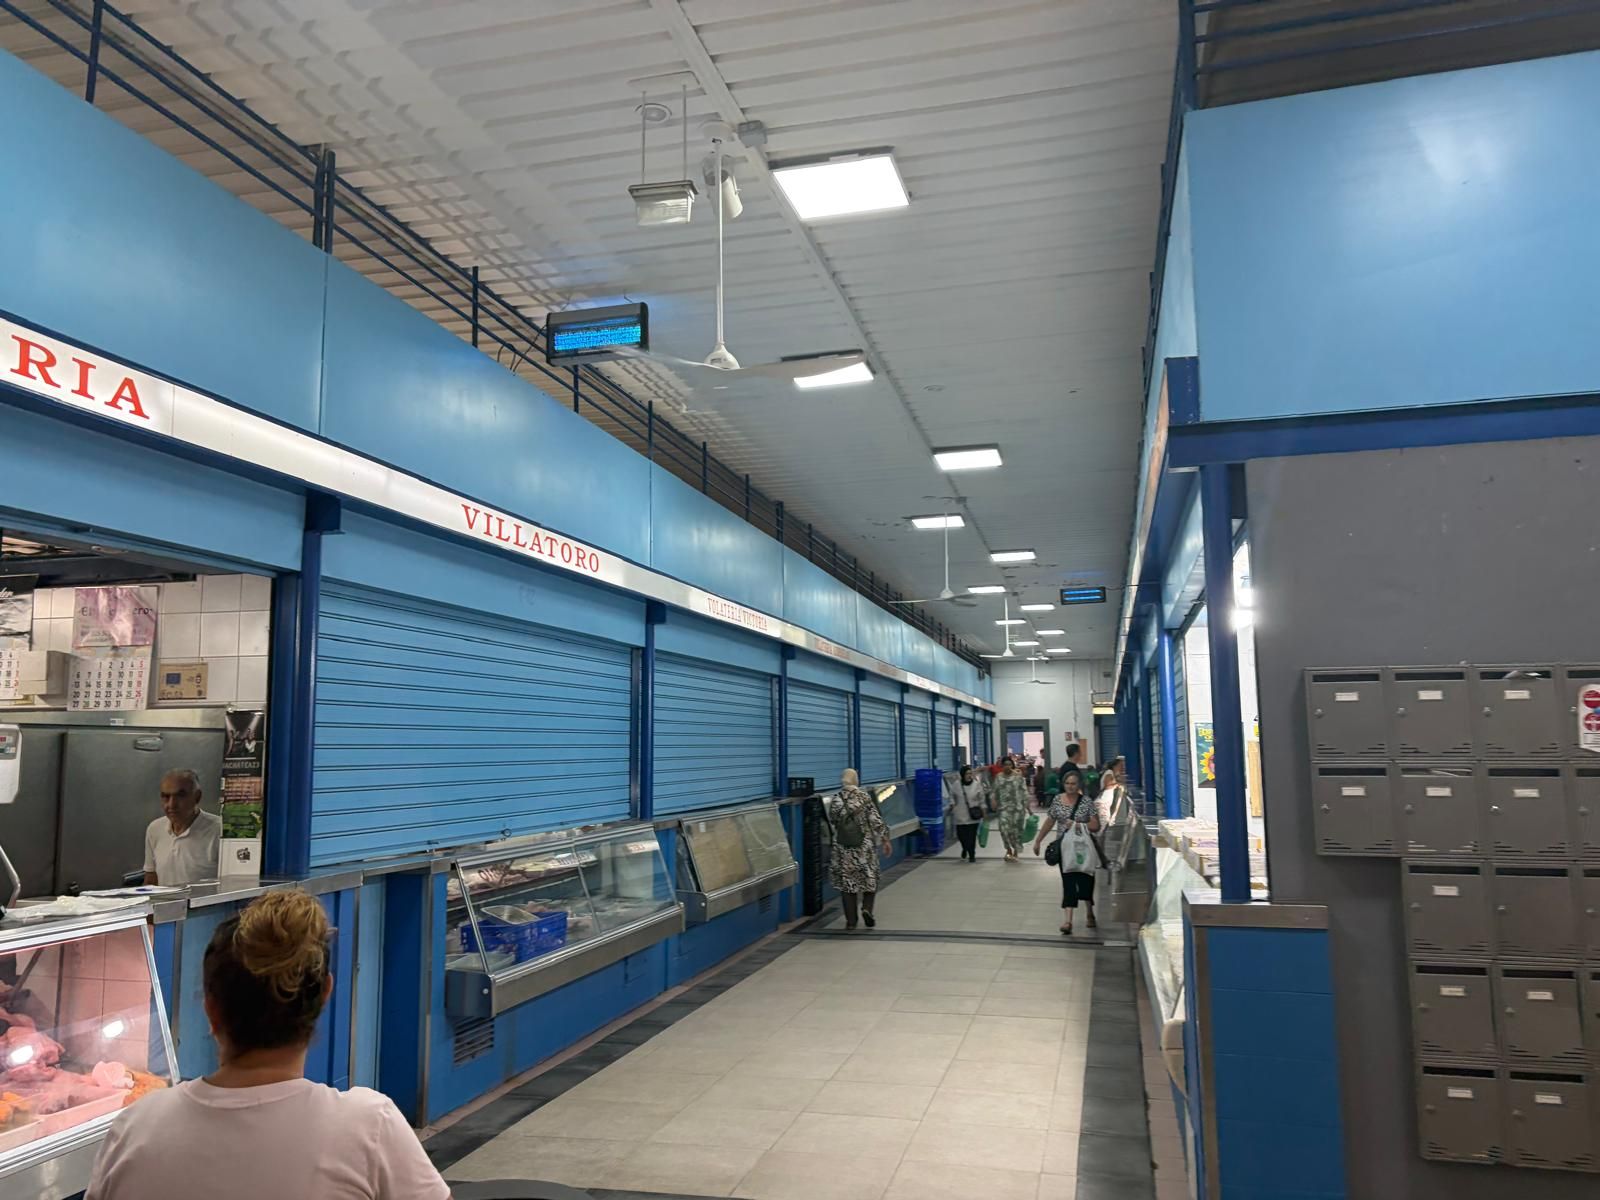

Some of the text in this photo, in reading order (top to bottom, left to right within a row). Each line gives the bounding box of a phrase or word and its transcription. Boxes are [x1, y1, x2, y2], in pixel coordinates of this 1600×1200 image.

[10, 334, 150, 420] RIA
[461, 503, 599, 573] VILLATORO
[742, 610, 768, 631] VICTORIA
